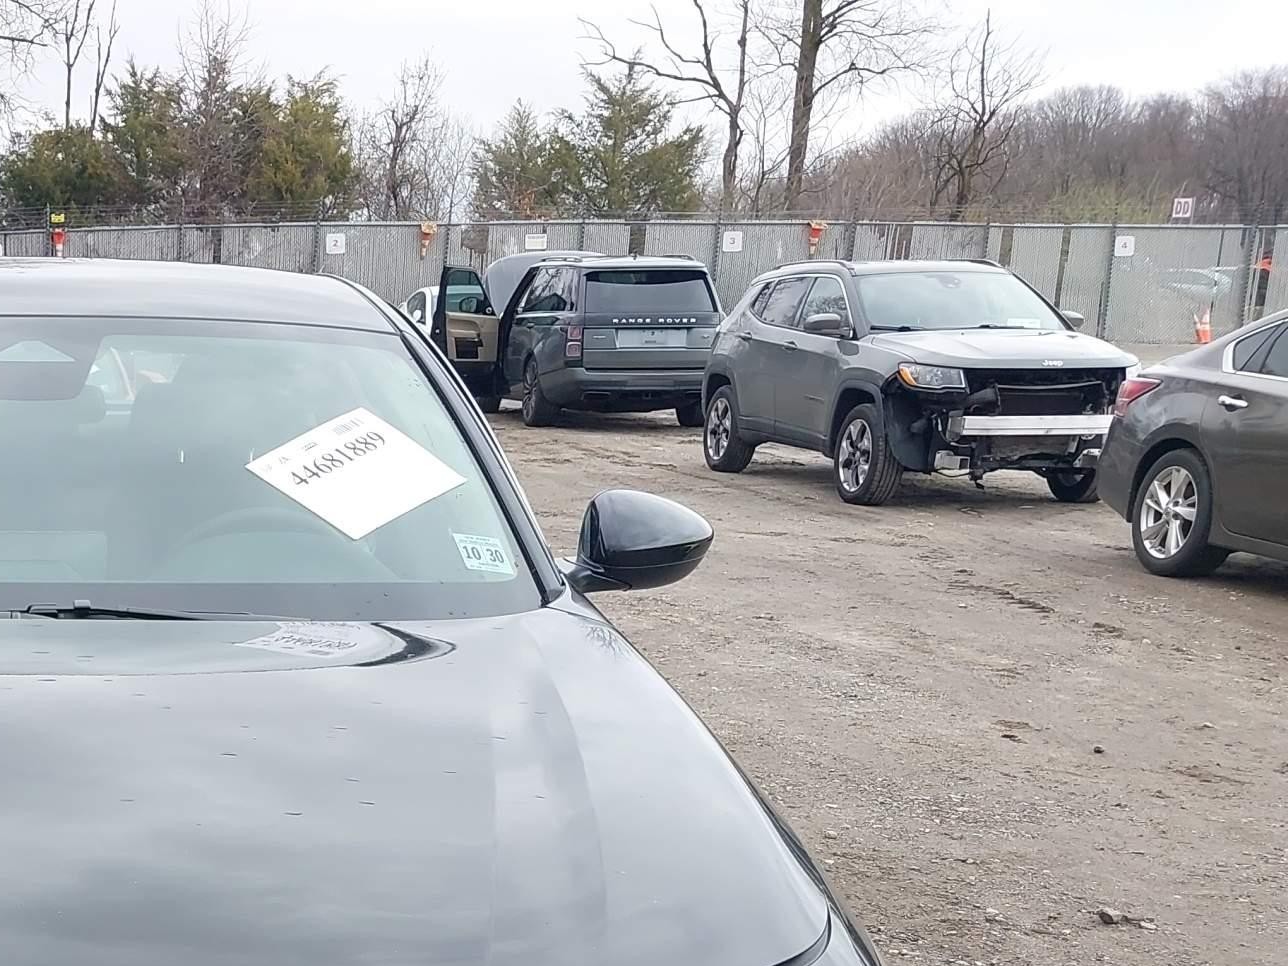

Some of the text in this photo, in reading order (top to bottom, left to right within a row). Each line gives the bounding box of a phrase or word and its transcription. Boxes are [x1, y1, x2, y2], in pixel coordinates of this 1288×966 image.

[1174, 200, 1191, 216] DD
[332, 239, 339, 248] 2
[729, 237, 736, 245] 3
[1041, 359, 1064, 367] Jeep
[290, 431, 385, 486] 44681889
[463, 545, 505, 564] 10 30
